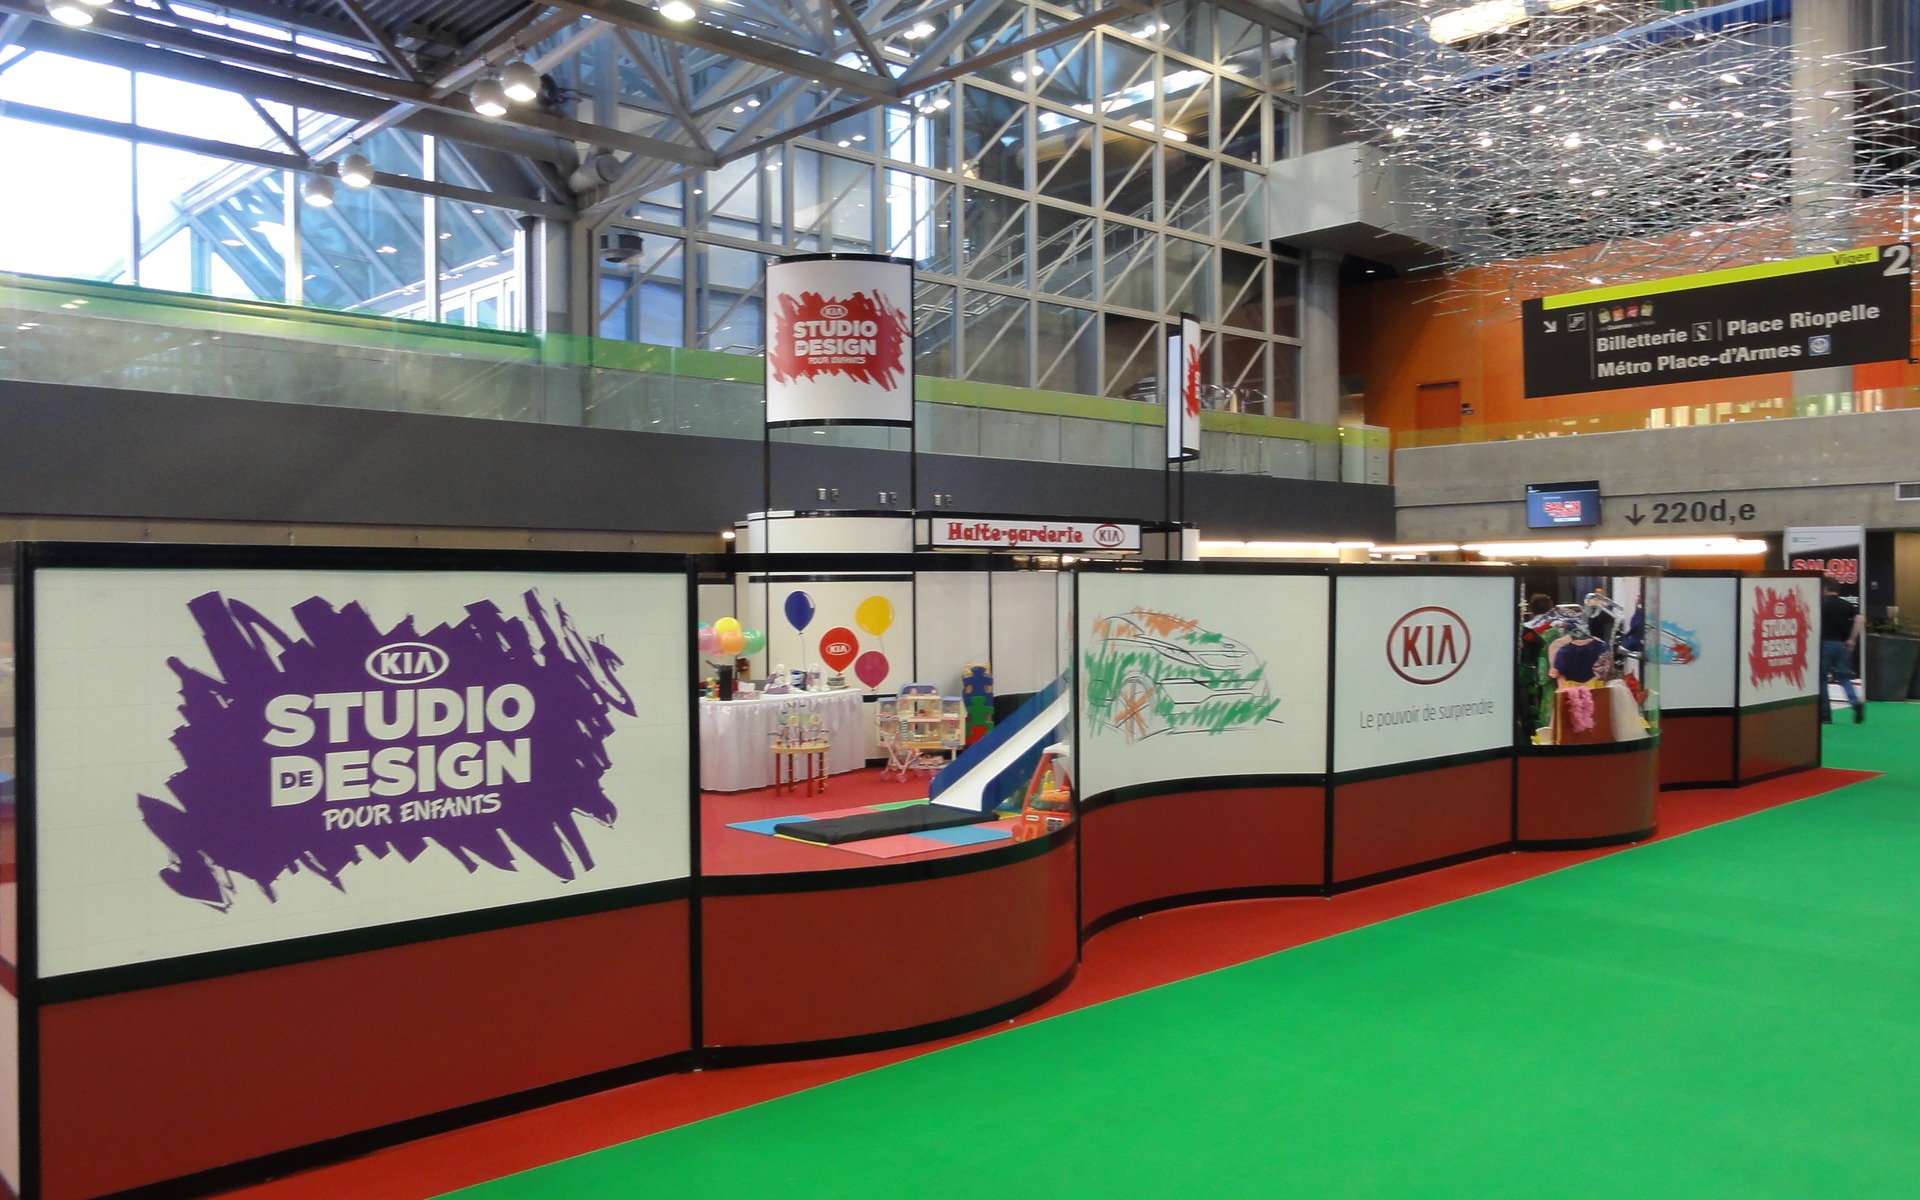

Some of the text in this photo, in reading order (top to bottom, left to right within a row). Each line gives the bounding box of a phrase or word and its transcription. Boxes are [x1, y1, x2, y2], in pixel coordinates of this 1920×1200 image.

[1832, 252, 1871, 266] Viger
[1882, 244, 1911, 276] 2
[793, 320, 878, 338] STUDIO
[1596, 304, 1880, 352] Billetterie Place Riopelle
[794, 338, 877, 356] DESIGN
[1597, 344, 1802, 377] Métro Place-d'Armes
[1652, 498, 1756, 526] 220d,e
[947, 522, 1121, 546] Halte-garderie KIA
[1761, 618, 1798, 637] STUDIO
[1402, 624, 1458, 668] KIA
[380, 651, 436, 676] KIA
[262, 683, 536, 748] STUDIO
[1359, 698, 1494, 731] Le pouvoir de surprendre
[270, 737, 532, 808] DESIGN
[279, 769, 314, 790] DE
[322, 792, 501, 831] POUR ENFANTS
